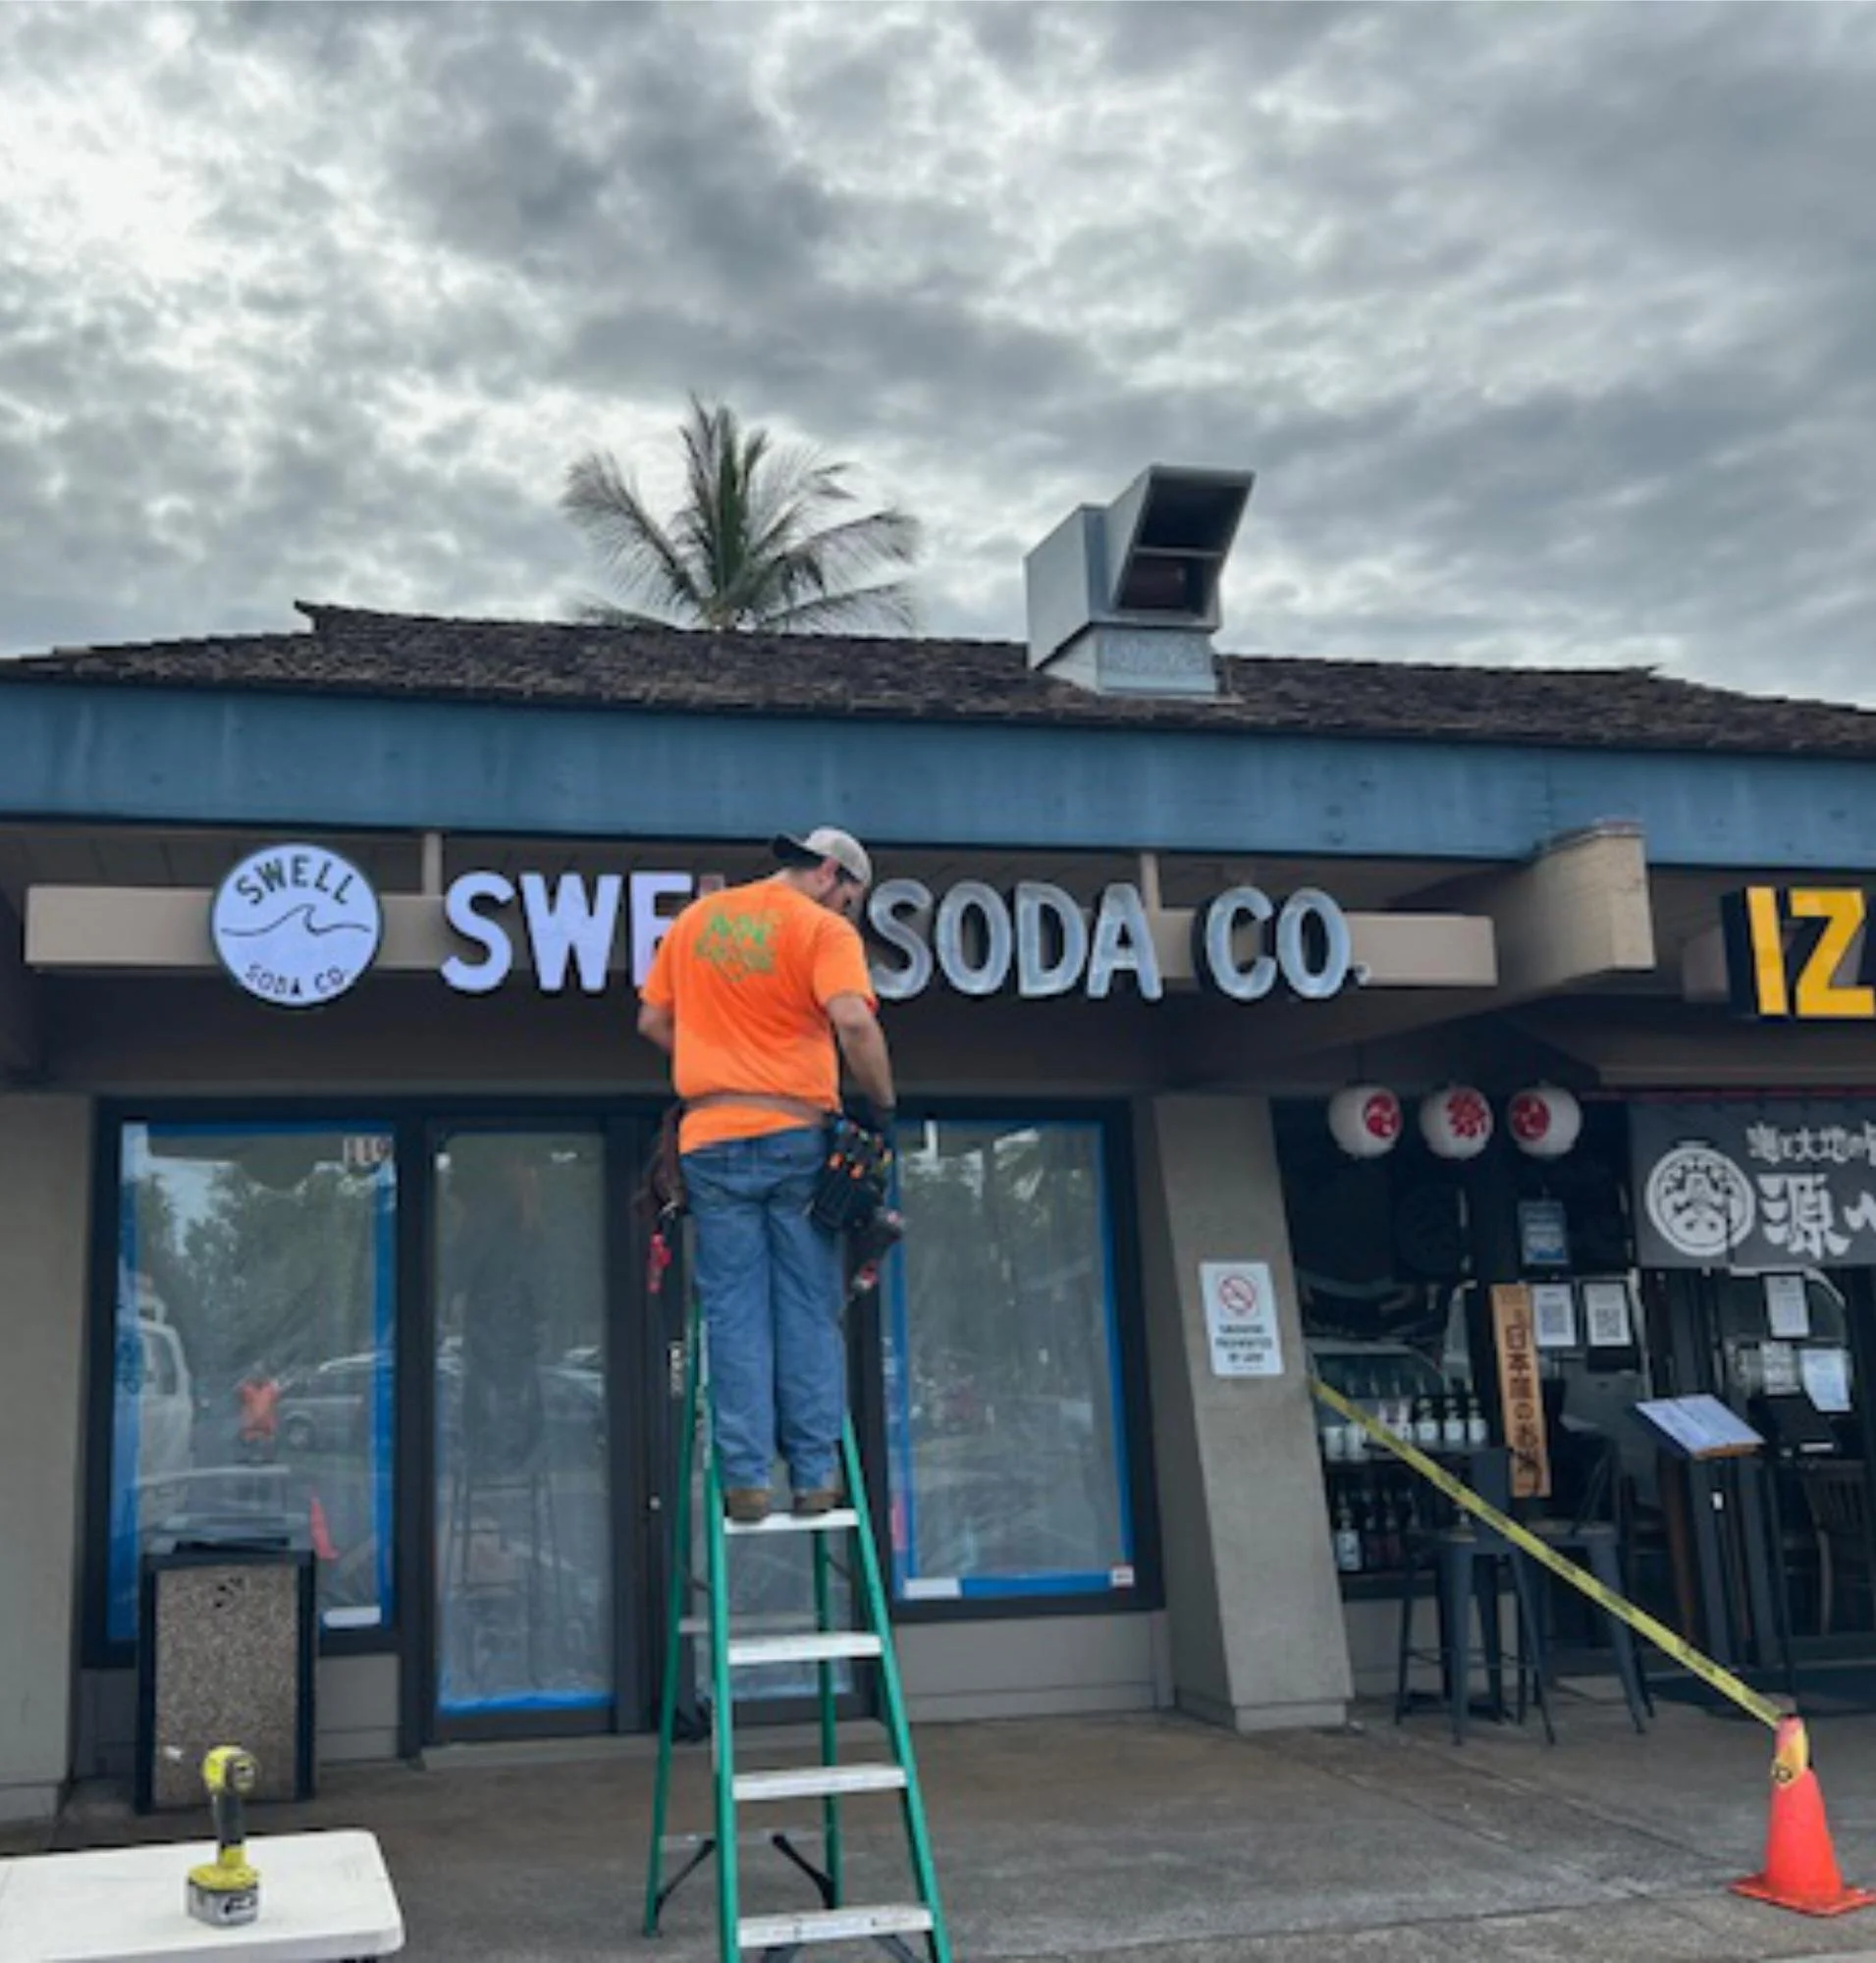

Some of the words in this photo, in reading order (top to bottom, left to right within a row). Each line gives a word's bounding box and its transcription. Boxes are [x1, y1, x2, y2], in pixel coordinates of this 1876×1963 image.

[235, 855, 354, 906] SWELL
[868, 879, 1162, 1000] SODA
[1206, 885, 1371, 1000] CO.
[245, 964, 303, 997] SODA
